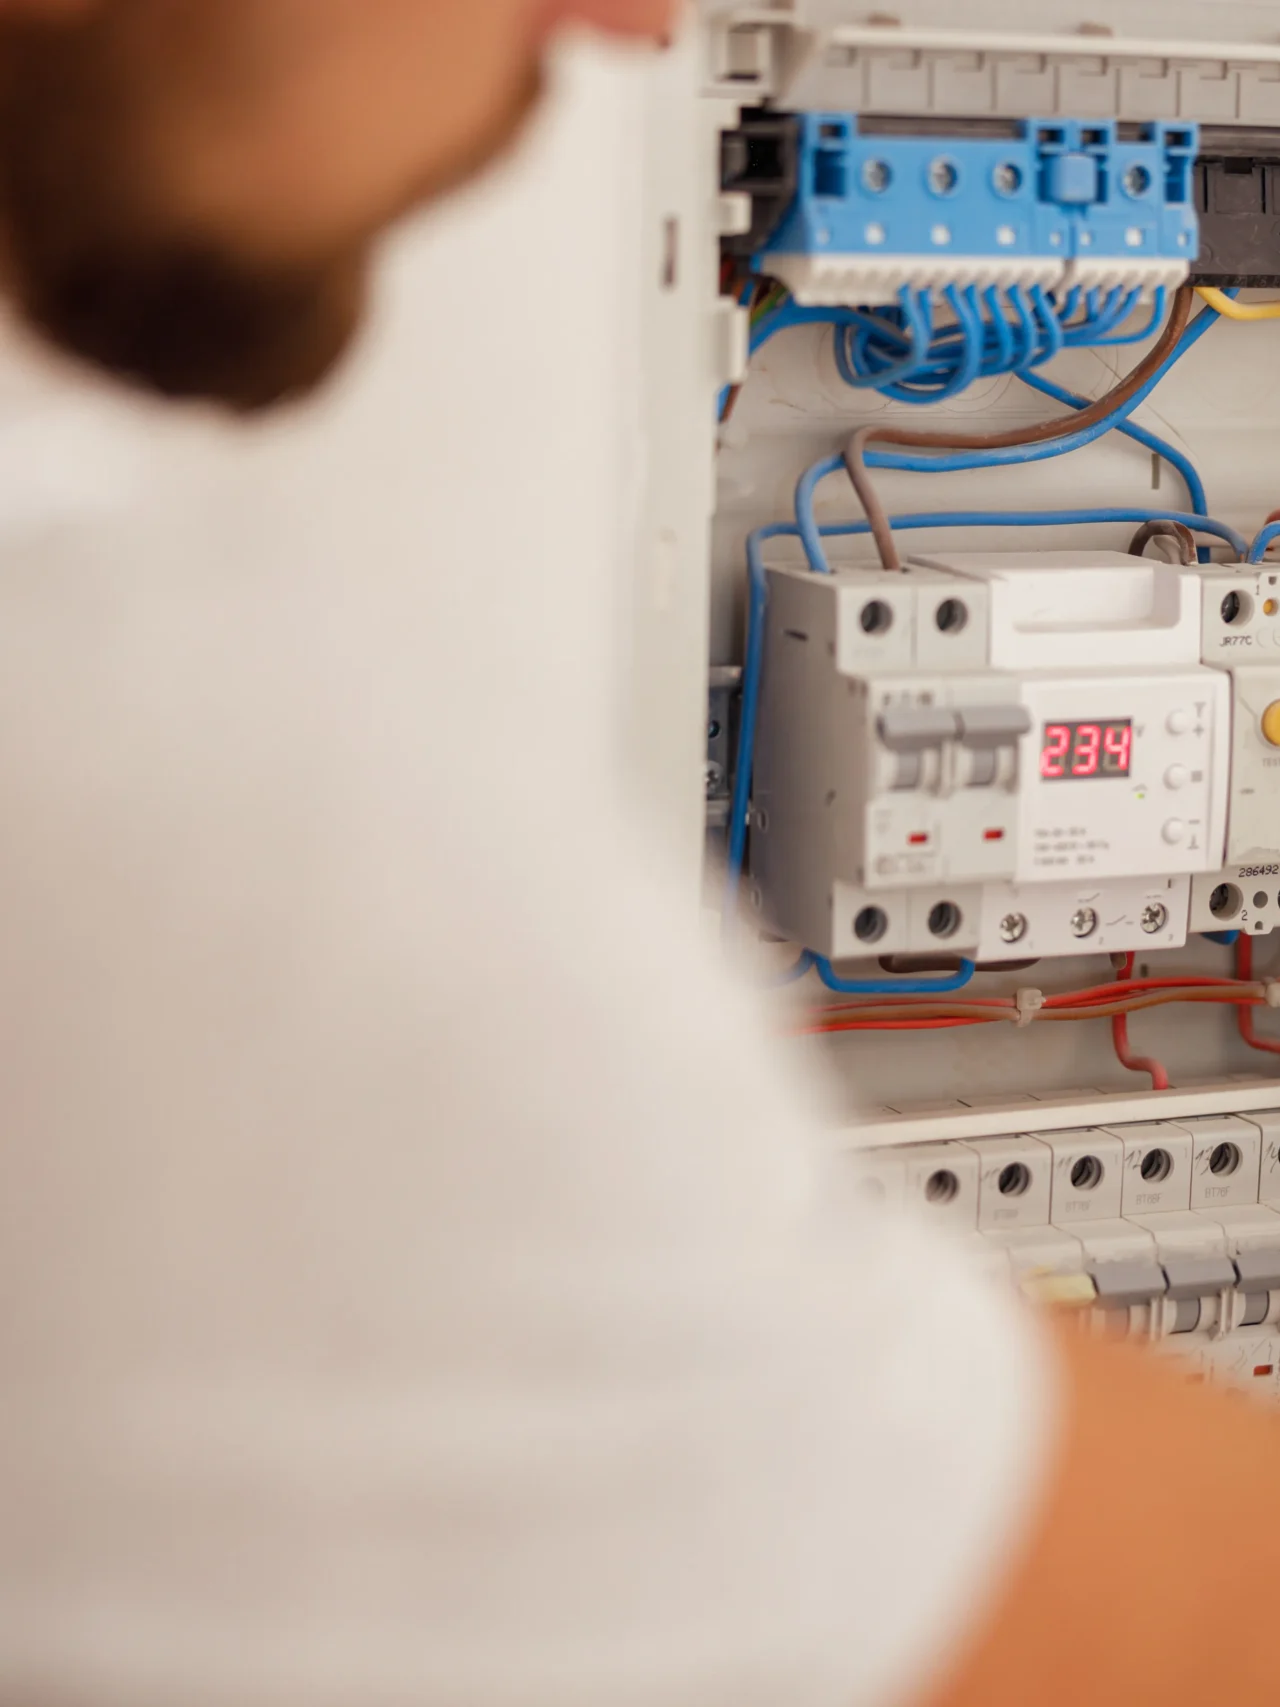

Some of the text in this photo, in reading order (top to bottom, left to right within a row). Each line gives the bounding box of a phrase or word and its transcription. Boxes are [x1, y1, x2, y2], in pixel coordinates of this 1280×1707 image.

[1255, 584, 1261, 596] 1
[1219, 635, 1252, 647] JR77C
[1039, 725, 1132, 777] 234
[1238, 864, 1280, 878] 286492
[1241, 910, 1248, 921] 2
